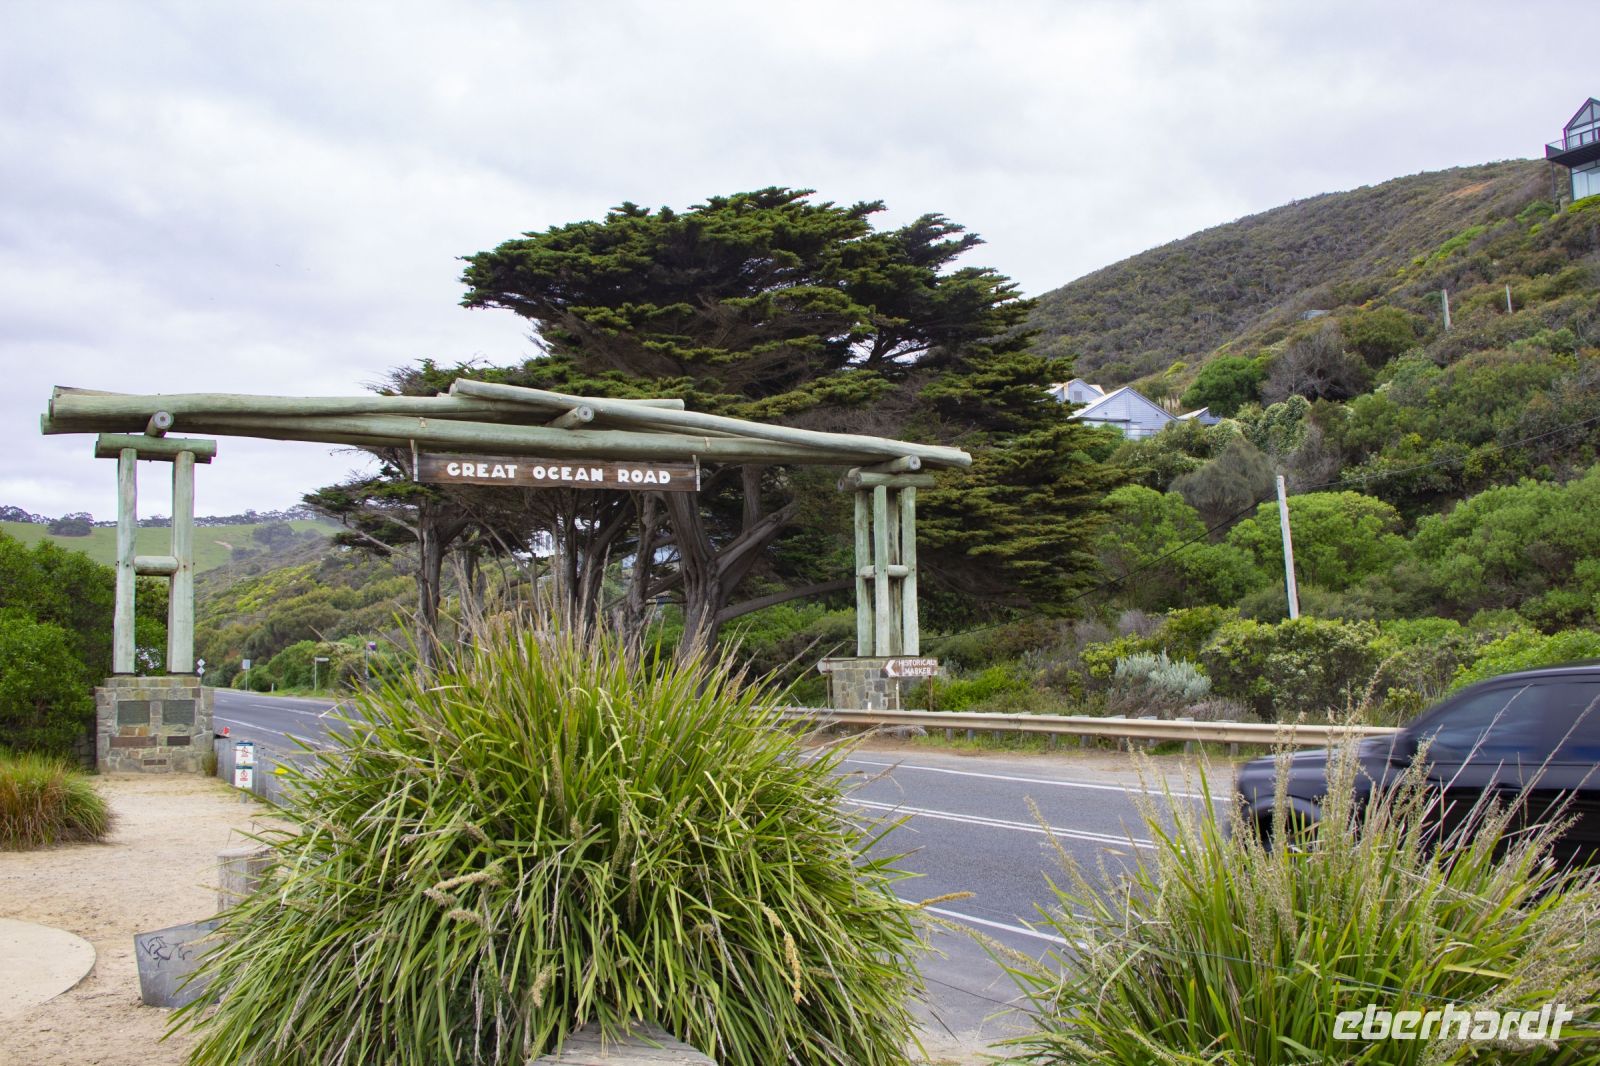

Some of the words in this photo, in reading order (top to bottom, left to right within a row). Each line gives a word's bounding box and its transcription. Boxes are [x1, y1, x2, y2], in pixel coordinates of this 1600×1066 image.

[447, 462, 517, 479] GREAT
[533, 466, 603, 482] OCEAN
[617, 469, 671, 484] ROAD
[904, 667, 931, 675] MARKER
